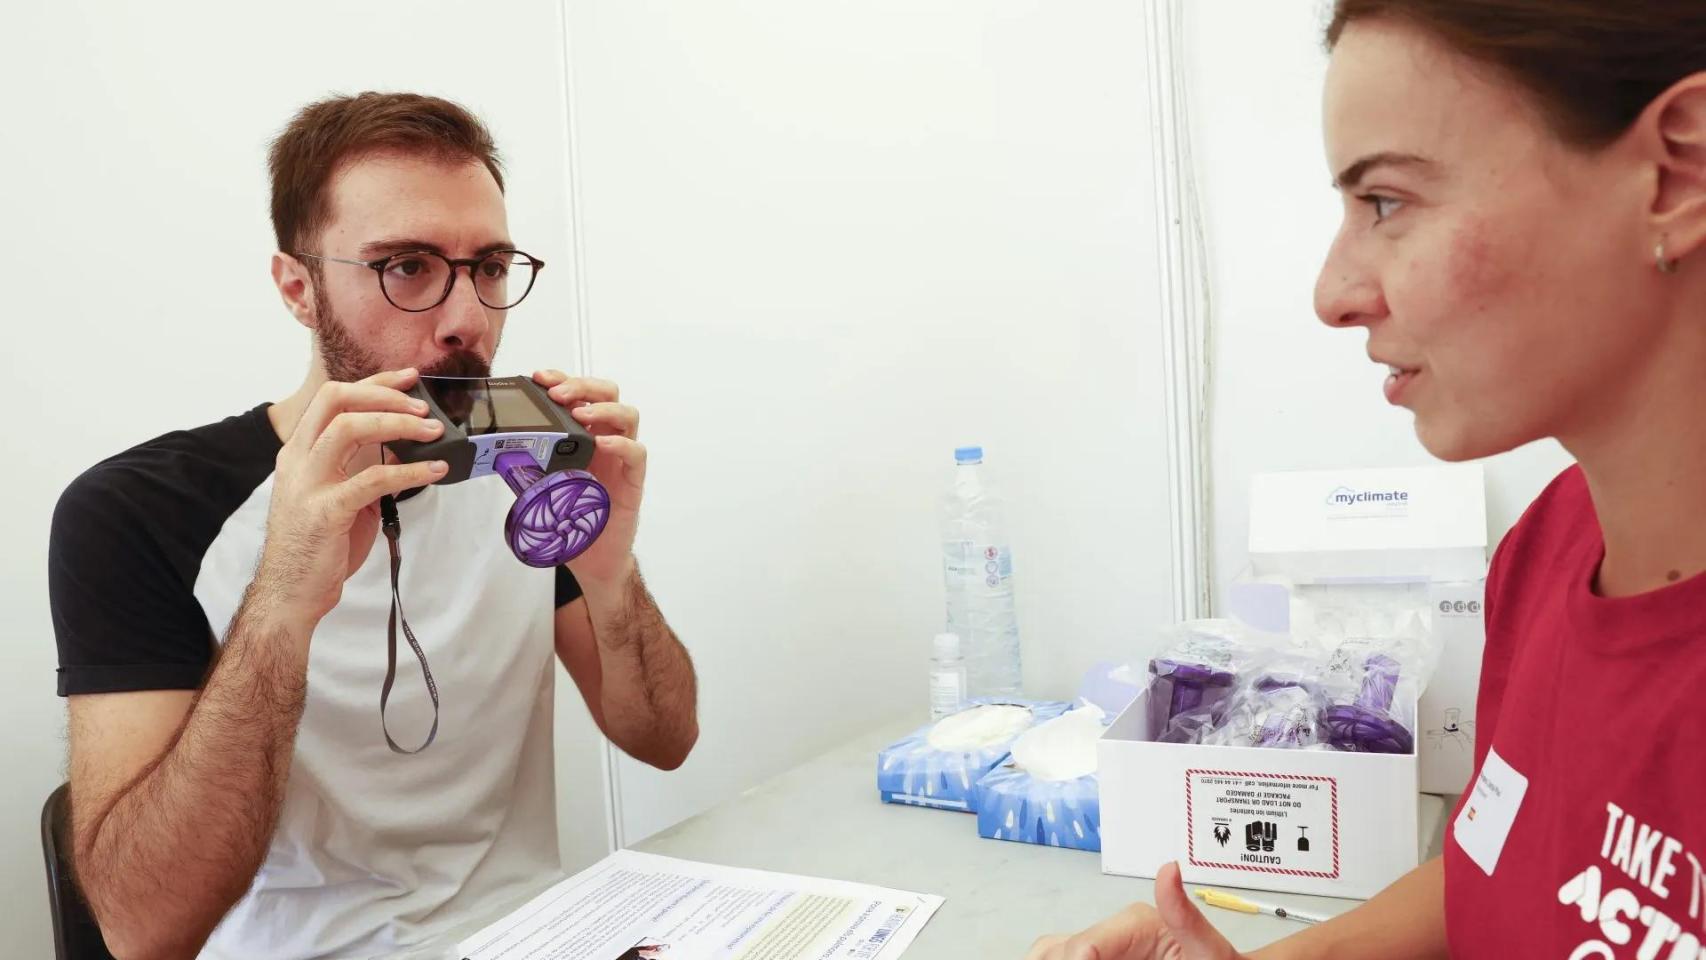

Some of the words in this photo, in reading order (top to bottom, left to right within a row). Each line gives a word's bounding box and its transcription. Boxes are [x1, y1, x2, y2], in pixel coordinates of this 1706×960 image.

[1335, 490, 1409, 506] myclimate
[1226, 790, 1254, 798] DAMAGED
[1263, 792, 1291, 800] PACKAGE
[1216, 796, 1250, 805] TRANSPORT
[1251, 798, 1260, 806] OR
[1230, 808, 1254, 816] batteries
[1266, 810, 1288, 818] Lithium
[1600, 801, 1683, 899] TAKE
[1240, 853, 1281, 865] CAUTION!
